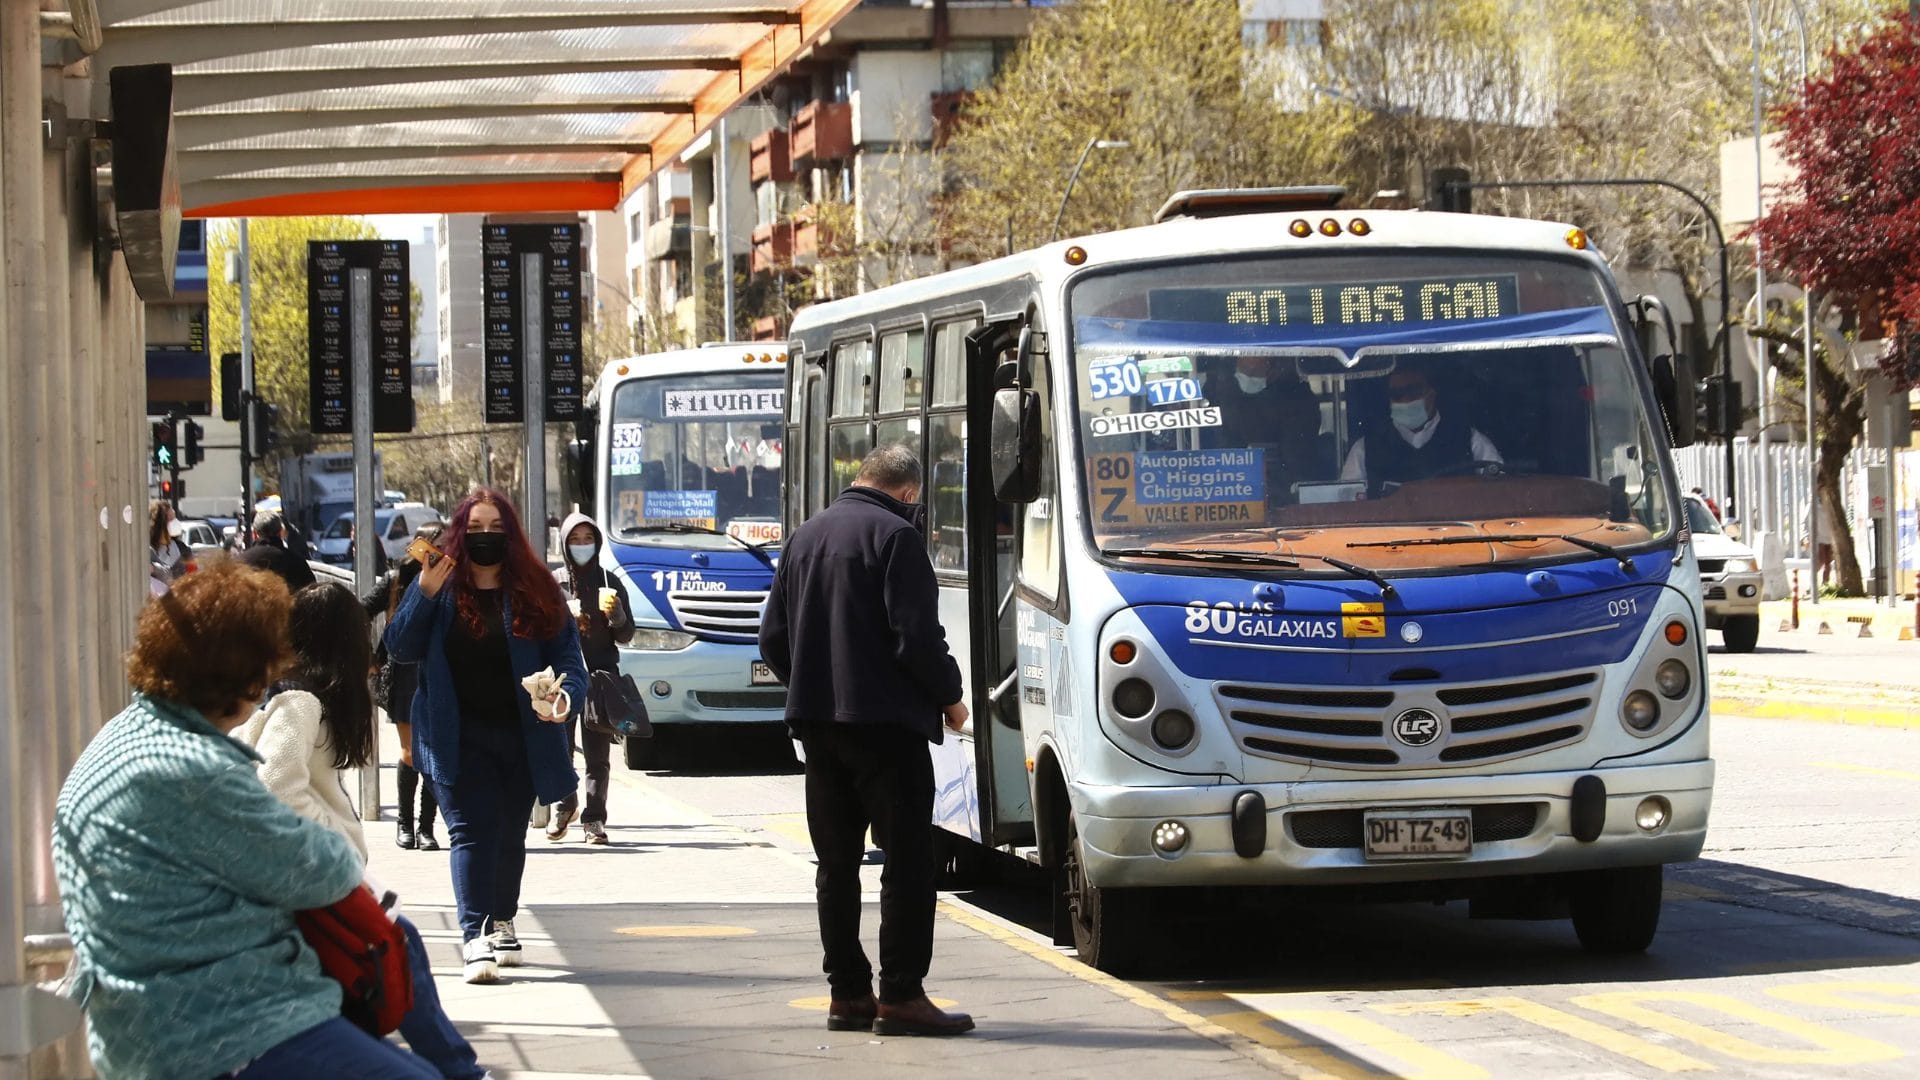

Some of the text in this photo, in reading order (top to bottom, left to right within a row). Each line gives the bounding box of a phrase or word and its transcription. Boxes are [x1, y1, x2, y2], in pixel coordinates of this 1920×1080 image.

[1090, 362, 1141, 399] 530
[1151, 378, 1197, 404] 170
[688, 395, 708, 411] 11
[713, 394, 752, 411] VIA
[1093, 409, 1219, 435] O'HIGGINS
[613, 427, 642, 447] 530
[1097, 457, 1130, 480] 80
[1141, 452, 1254, 470] Autopista-Mall
[1143, 483, 1253, 501] Chiguayante
[1100, 487, 1129, 523] Z
[1144, 504, 1250, 523] VALLE PIEDRA
[652, 571, 678, 591] 11
[681, 571, 702, 581] VIA
[681, 581, 727, 591] FUTURO
[1608, 598, 1637, 617] 091
[1184, 601, 1237, 635] 80
[1238, 620, 1338, 639] GALAXIAS
[1400, 719, 1435, 735] LR
